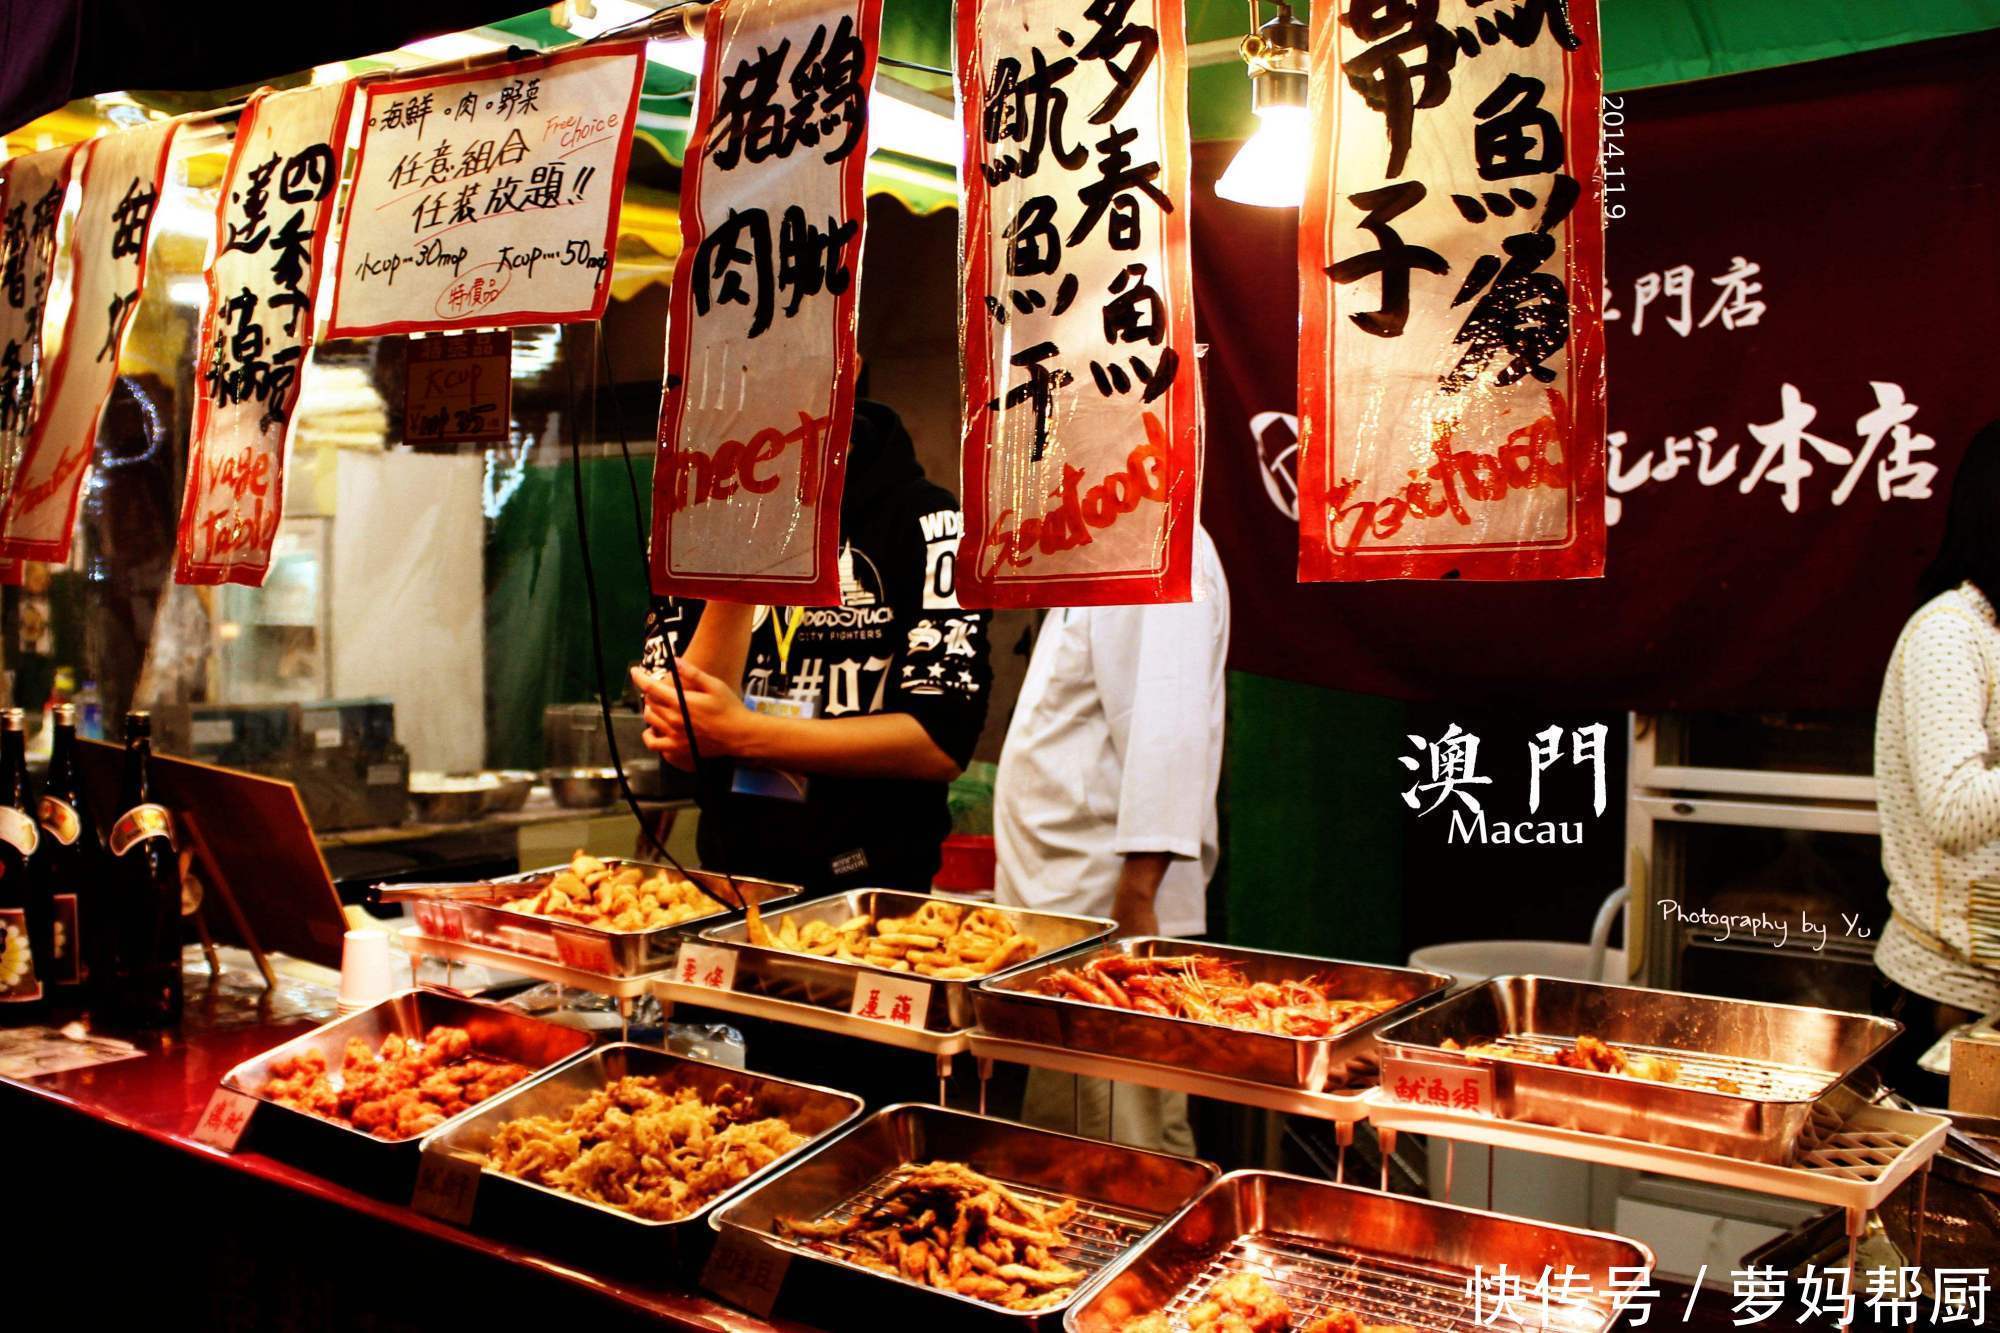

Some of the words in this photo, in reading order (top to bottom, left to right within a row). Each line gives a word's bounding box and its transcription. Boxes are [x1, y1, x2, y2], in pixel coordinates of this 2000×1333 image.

[388, 128, 531, 191] 任意組合
[1603, 256, 1768, 339] 門店
[829, 627, 884, 641] FIGHTERS
